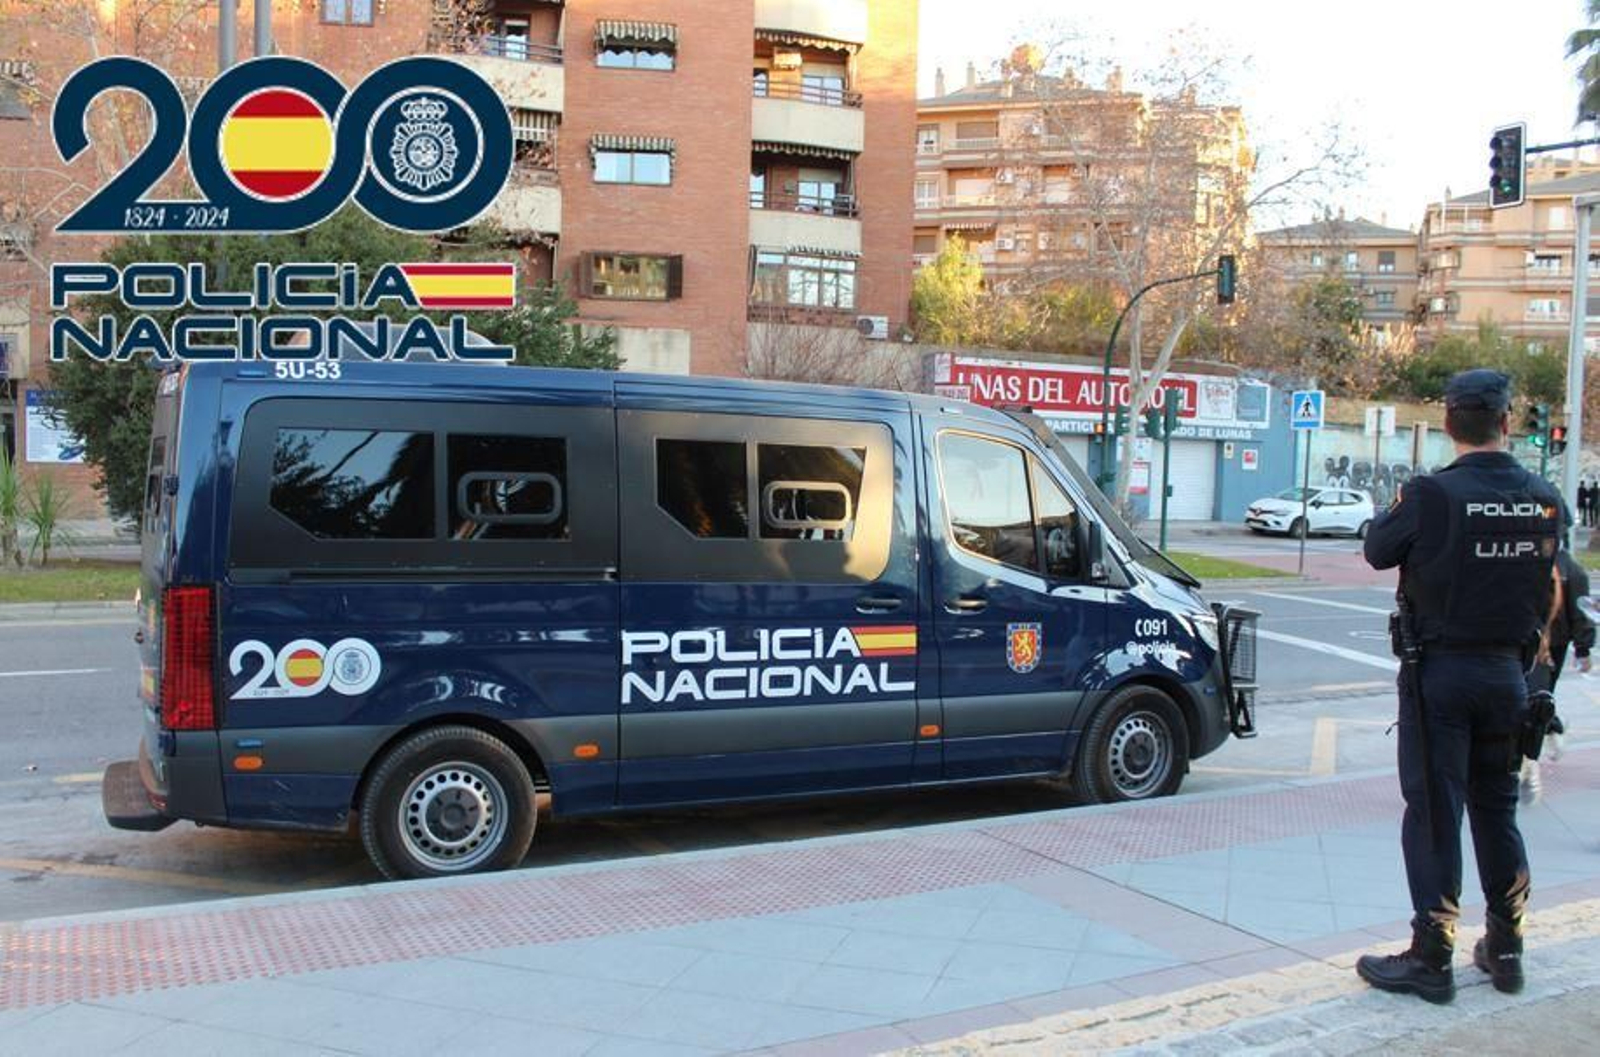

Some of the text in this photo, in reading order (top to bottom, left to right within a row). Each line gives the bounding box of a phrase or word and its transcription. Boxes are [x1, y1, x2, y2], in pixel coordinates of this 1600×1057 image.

[275, 360, 342, 379] 5U-53
[1028, 376, 1071, 404] DEL
[1215, 428, 1252, 440] LUNAS
[1475, 542, 1539, 557] U.I.P.
[229, 637, 381, 699] 200
[621, 662, 916, 704] NACIONAL
